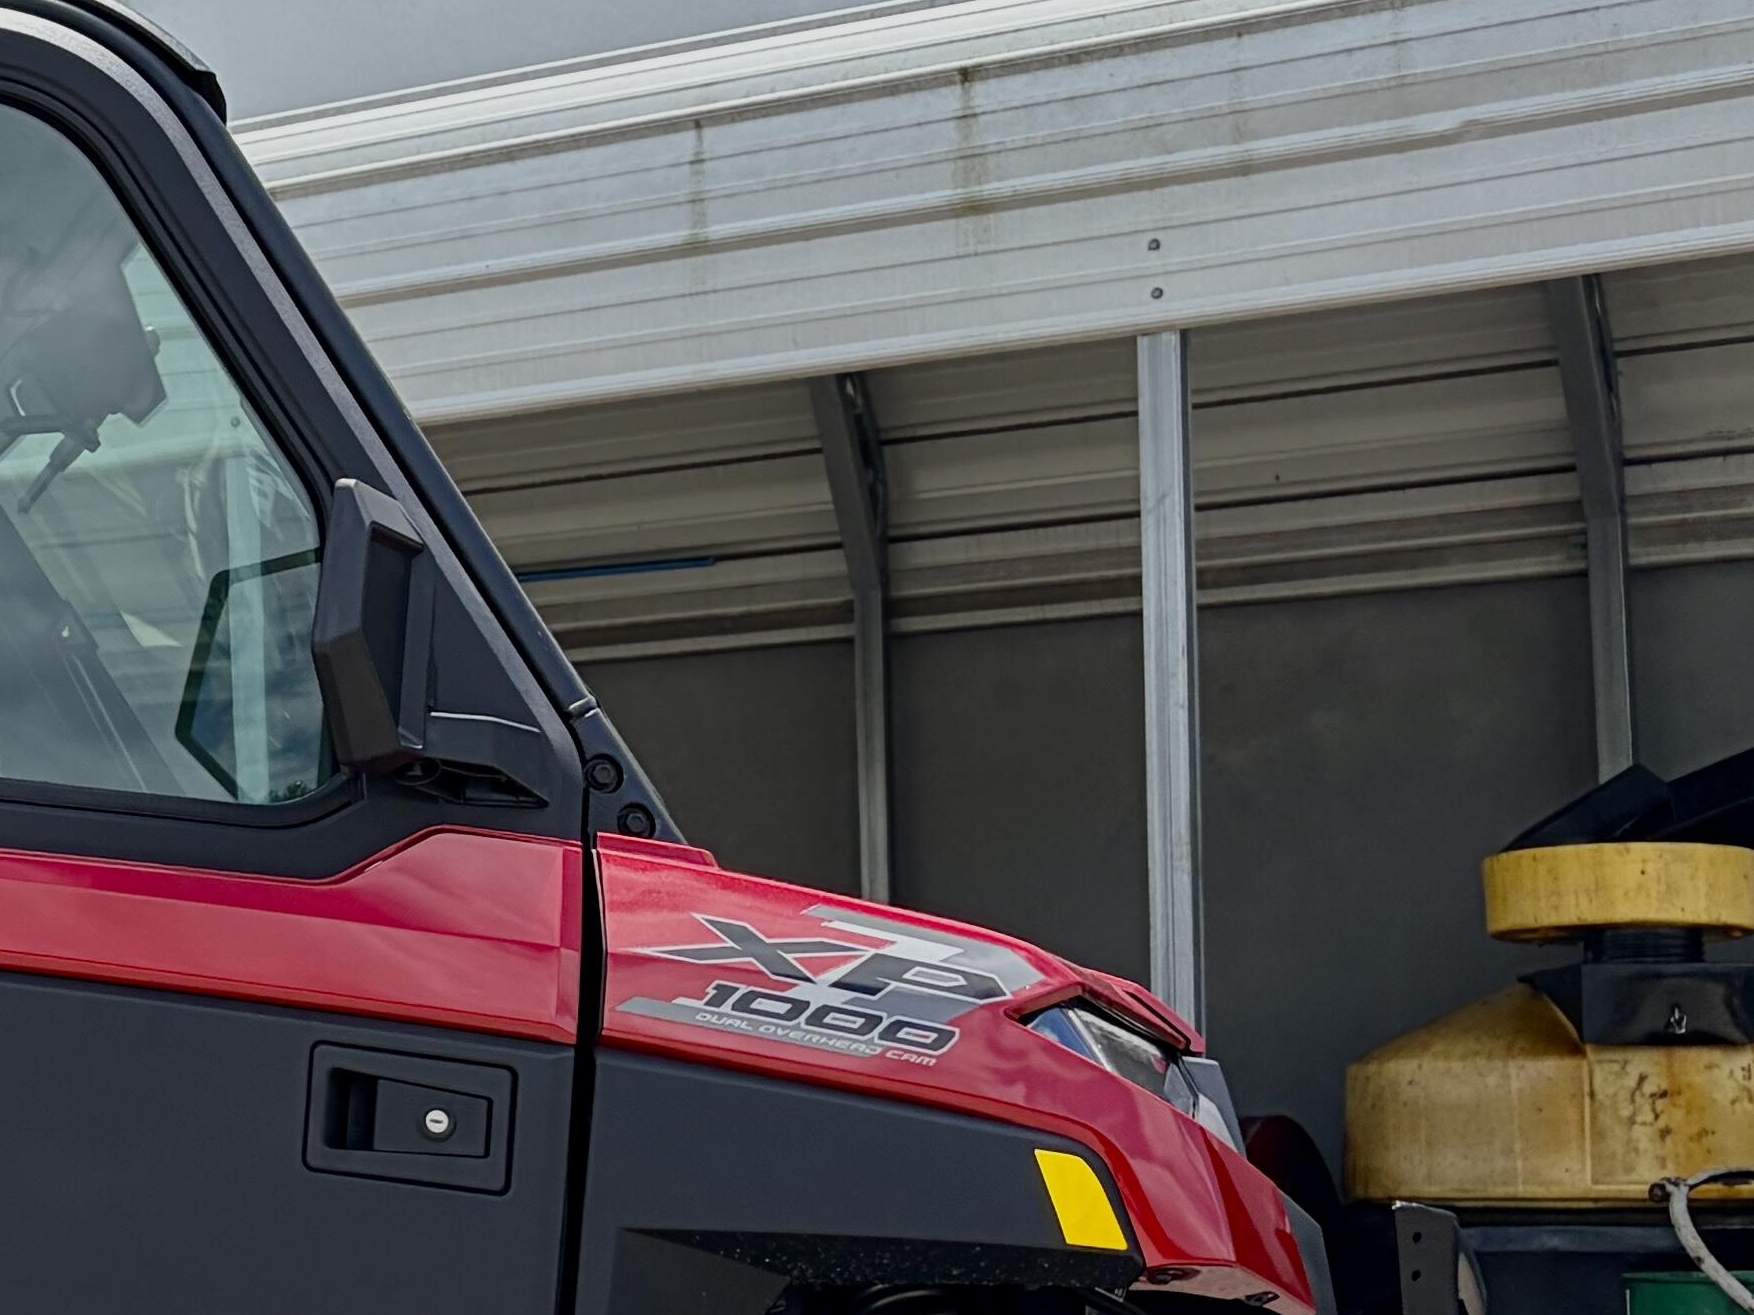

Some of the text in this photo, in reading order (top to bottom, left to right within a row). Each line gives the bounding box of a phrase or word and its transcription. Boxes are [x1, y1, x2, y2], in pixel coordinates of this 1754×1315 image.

[629, 912, 1013, 1004] XP
[695, 1011, 937, 1067] DUAL OVERHEAD CAM
[702, 980, 960, 1055] 1000
